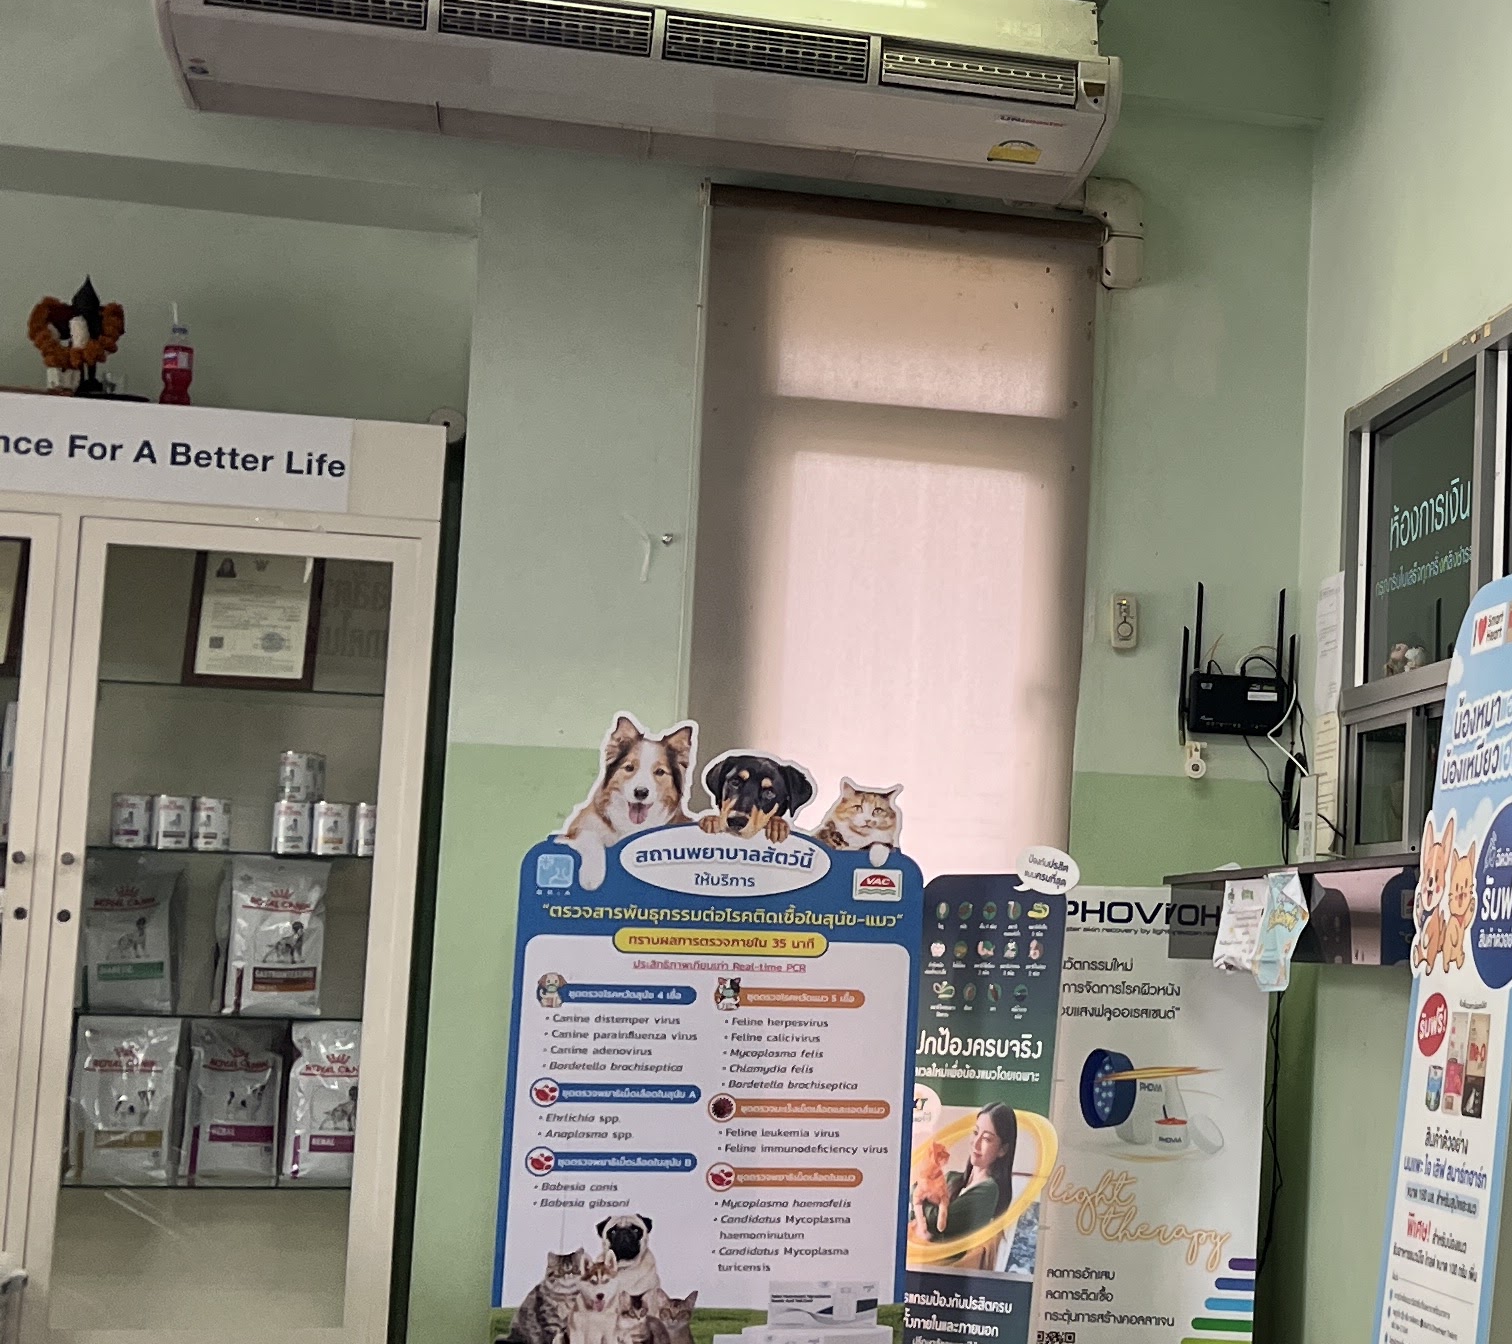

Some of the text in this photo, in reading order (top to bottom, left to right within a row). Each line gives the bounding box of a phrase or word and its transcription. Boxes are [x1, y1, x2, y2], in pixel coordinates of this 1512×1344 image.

[68, 434, 123, 461] For
[133, 439, 157, 463] A
[170, 442, 273, 472] Better
[286, 451, 346, 478] Life
[1390, 477, 1472, 551] ห้องการเงิน
[635, 846, 816, 869] สถานพยาบาลสัตว์นี้
[694, 871, 756, 888] ให้บริการ
[866, 877, 892, 886] VAC
[628, 935, 815, 949] ทราบผลการตรวจภายใน 35 นาที
[733, 962, 782, 973] Real-time
[786, 963, 806, 973] PCR
[552, 1014, 680, 1026] Canine distemper virus
[731, 1017, 829, 1028] Feline herpesvirus
[551, 1029, 697, 1041] Canine parainfluenza virus
[731, 1032, 820, 1043] Feline calicivirus
[550, 1045, 653, 1056] Canine adenovirus
[729, 1049, 824, 1059] Mycoplasma felis
[729, 1064, 813, 1075] Chlamydia felis
[546, 1113, 595, 1122] Ehrlichia
[545, 1130, 608, 1140] Anaplasma
[725, 1128, 840, 1138] Feline leukemia virus
[725, 1144, 888, 1155] Feline immunodeficiency virus
[541, 1182, 618, 1191] Babesia canis
[540, 1198, 630, 1209] Babesia gibsoni
[721, 1199, 851, 1209] Mycoplasma haemofelis
[1047, 1165, 1137, 1236] light
[720, 1215, 851, 1226] Candidatus Mycoplasma
[719, 1231, 805, 1240] haemominutum
[1098, 1205, 1231, 1272] therapy
[718, 1247, 849, 1258] Candidatus Mycoplasma
[717, 1263, 771, 1272] turicensis
